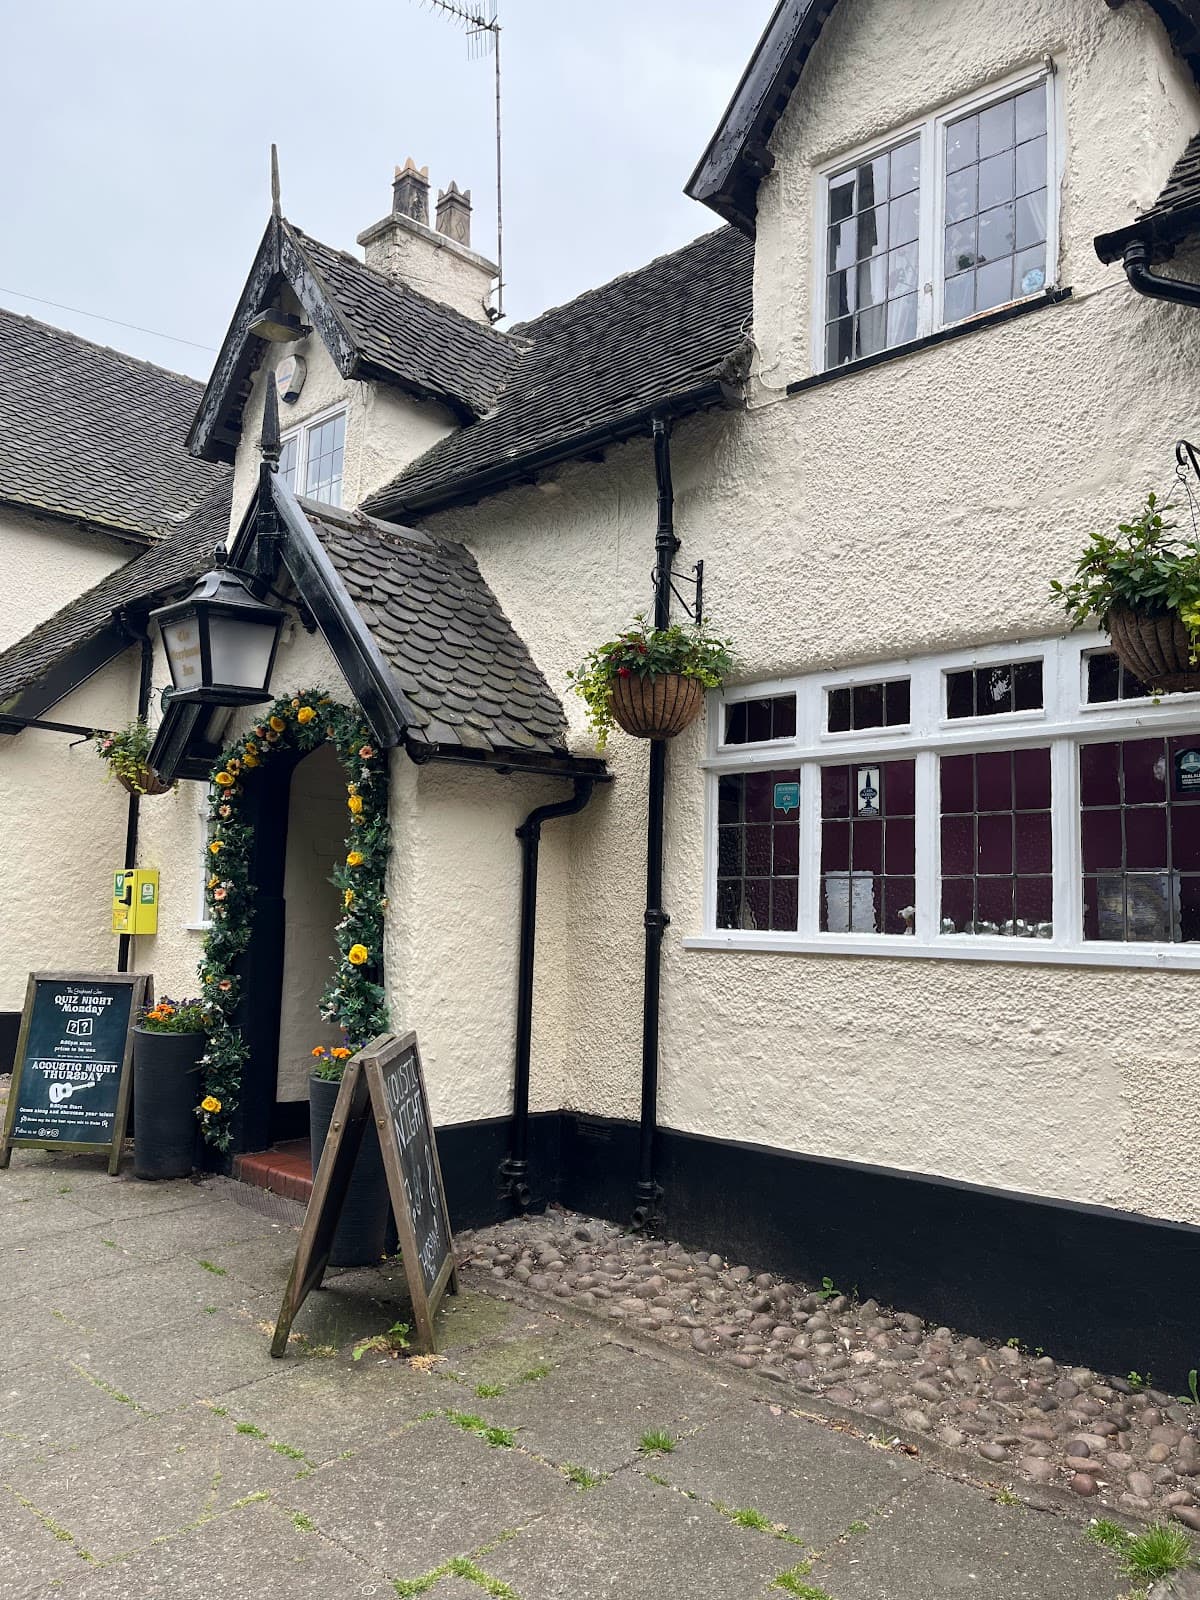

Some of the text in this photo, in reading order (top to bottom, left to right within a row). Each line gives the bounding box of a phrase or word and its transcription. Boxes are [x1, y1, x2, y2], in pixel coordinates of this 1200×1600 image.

[54, 995, 114, 1006] QUIZ NIGHT
[61, 1003, 105, 1016] Monday
[32, 1061, 118, 1073] ACOUSTIC NIGHT
[43, 1070, 104, 1082] THURSDAY
[394, 1089, 424, 1158] NIGHT
